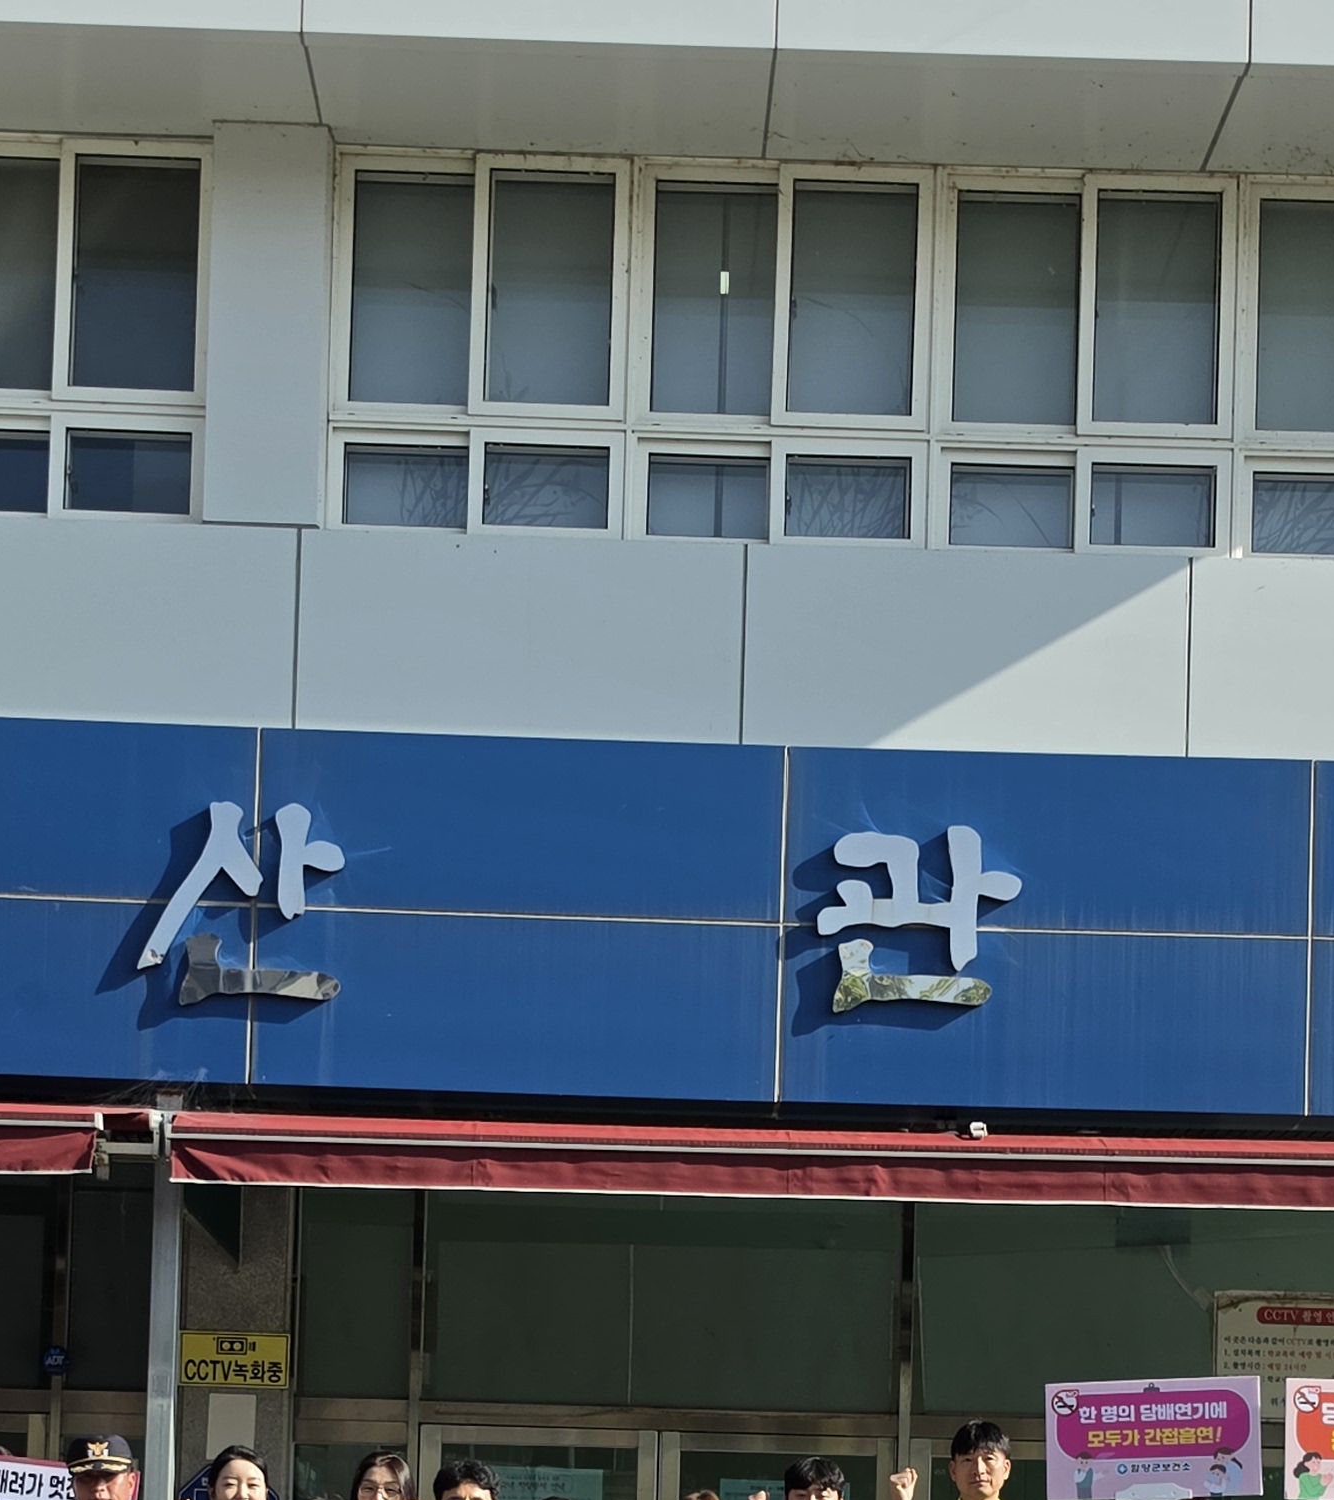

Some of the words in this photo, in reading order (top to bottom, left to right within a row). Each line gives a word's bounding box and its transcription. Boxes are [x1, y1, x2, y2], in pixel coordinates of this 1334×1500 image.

[1264, 1308, 1299, 1322] CCTV
[1302, 1310, 1323, 1324] 촬영
[184, 1359, 283, 1384] CCTV녹화중
[1078, 1406, 1097, 1424] 한
[1101, 1405, 1136, 1424] 명의
[1140, 1401, 1227, 1422] 담배연기에
[1087, 1429, 1141, 1448] 모두가
[1144, 1427, 1223, 1447] 간접흡연!
[1130, 1462, 1192, 1474] 함양군보건소
